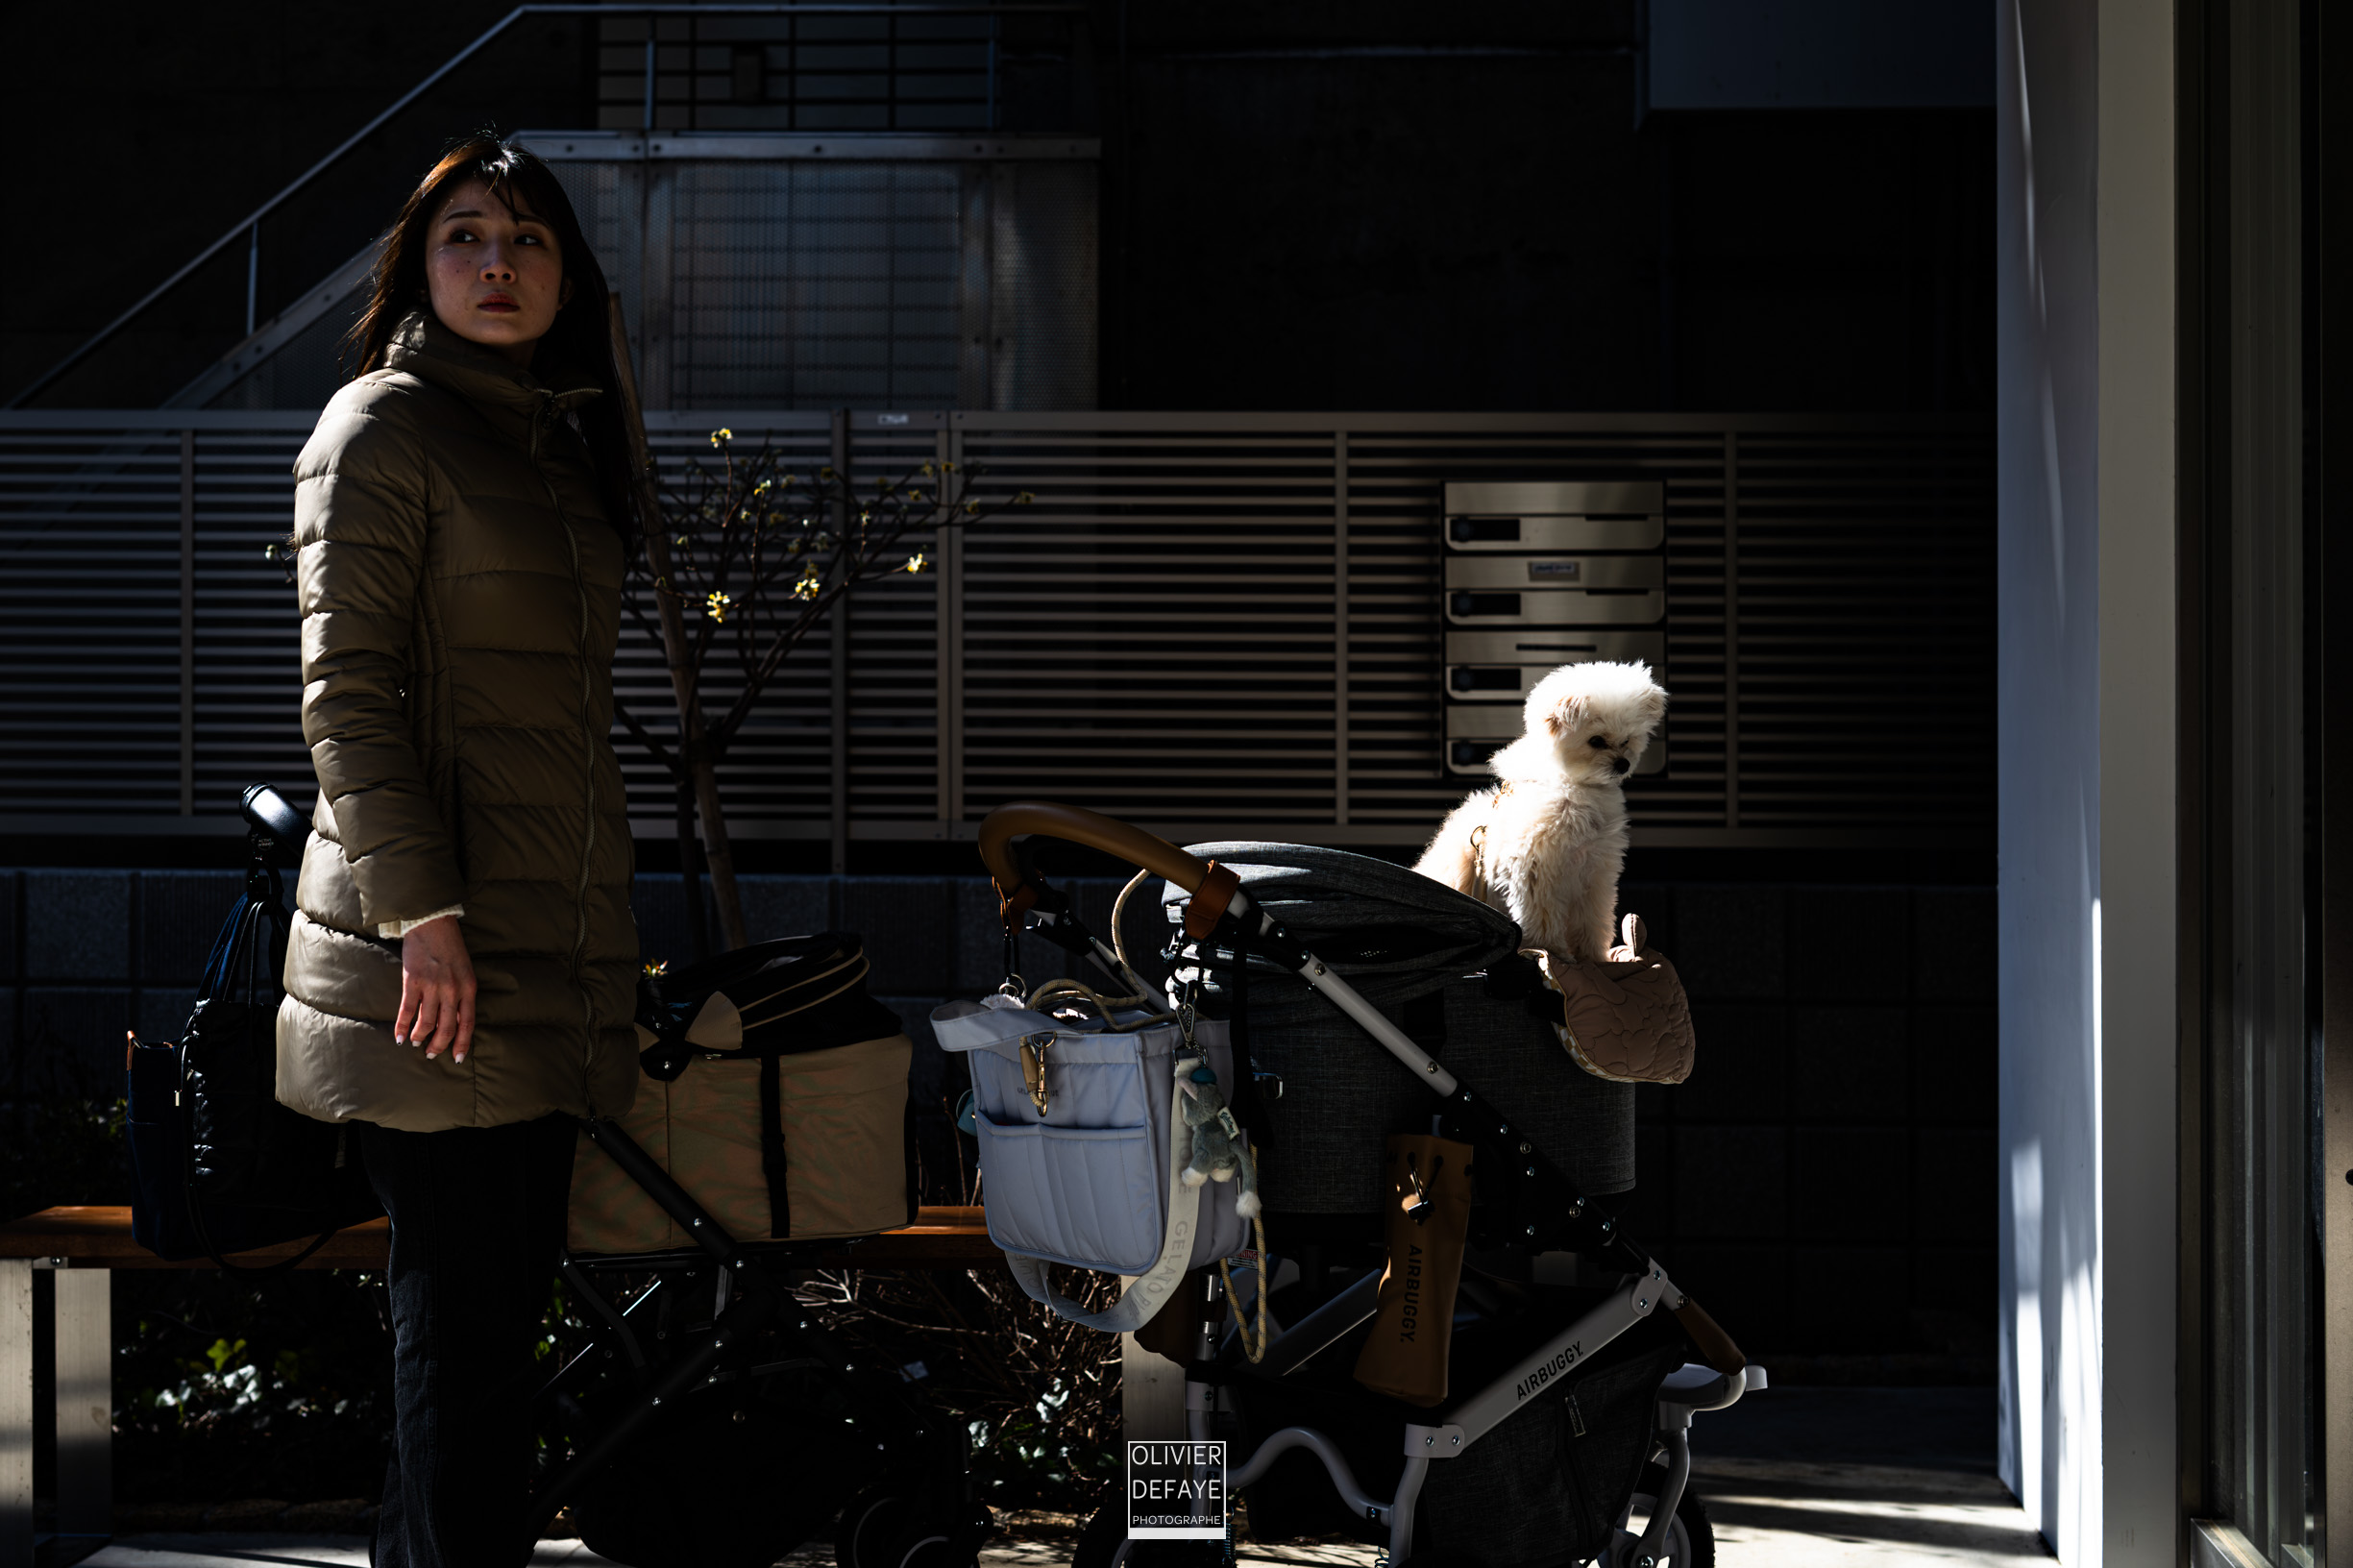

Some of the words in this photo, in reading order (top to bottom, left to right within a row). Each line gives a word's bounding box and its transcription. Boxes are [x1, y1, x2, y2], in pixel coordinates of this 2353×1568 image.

[1146, 1220, 1189, 1294] GELATO
[1399, 1244, 1423, 1343] AIRBUGGY.
[1517, 1340, 1583, 1400] AIRBUGGY.
